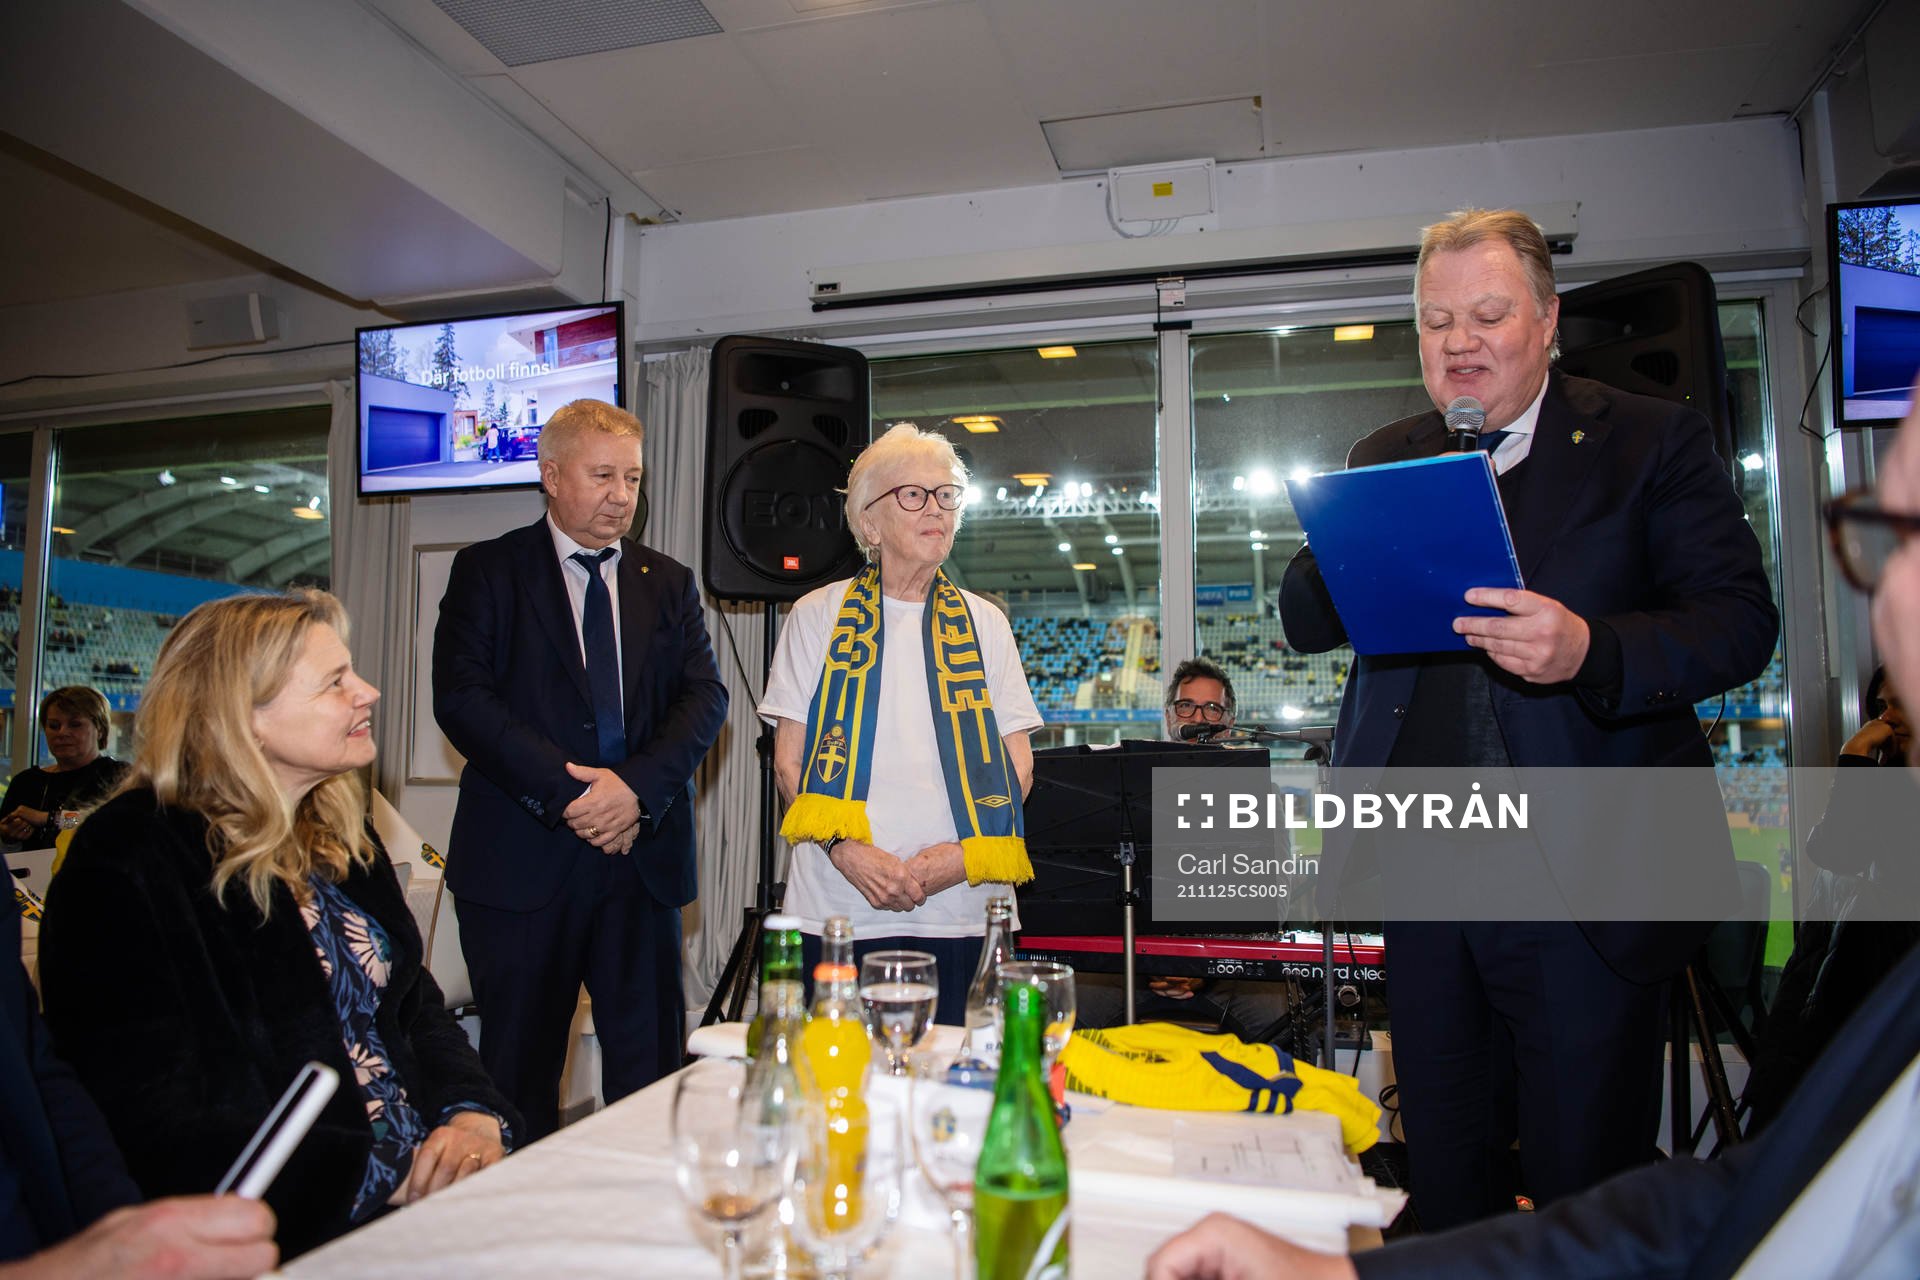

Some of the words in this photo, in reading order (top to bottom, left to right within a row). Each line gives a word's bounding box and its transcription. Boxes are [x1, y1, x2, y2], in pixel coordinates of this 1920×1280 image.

[421, 369, 450, 386] Där
[453, 363, 505, 383] fotboll
[509, 360, 551, 379] finns
[743, 490, 844, 532] EON
[1353, 966, 1387, 981] elec
